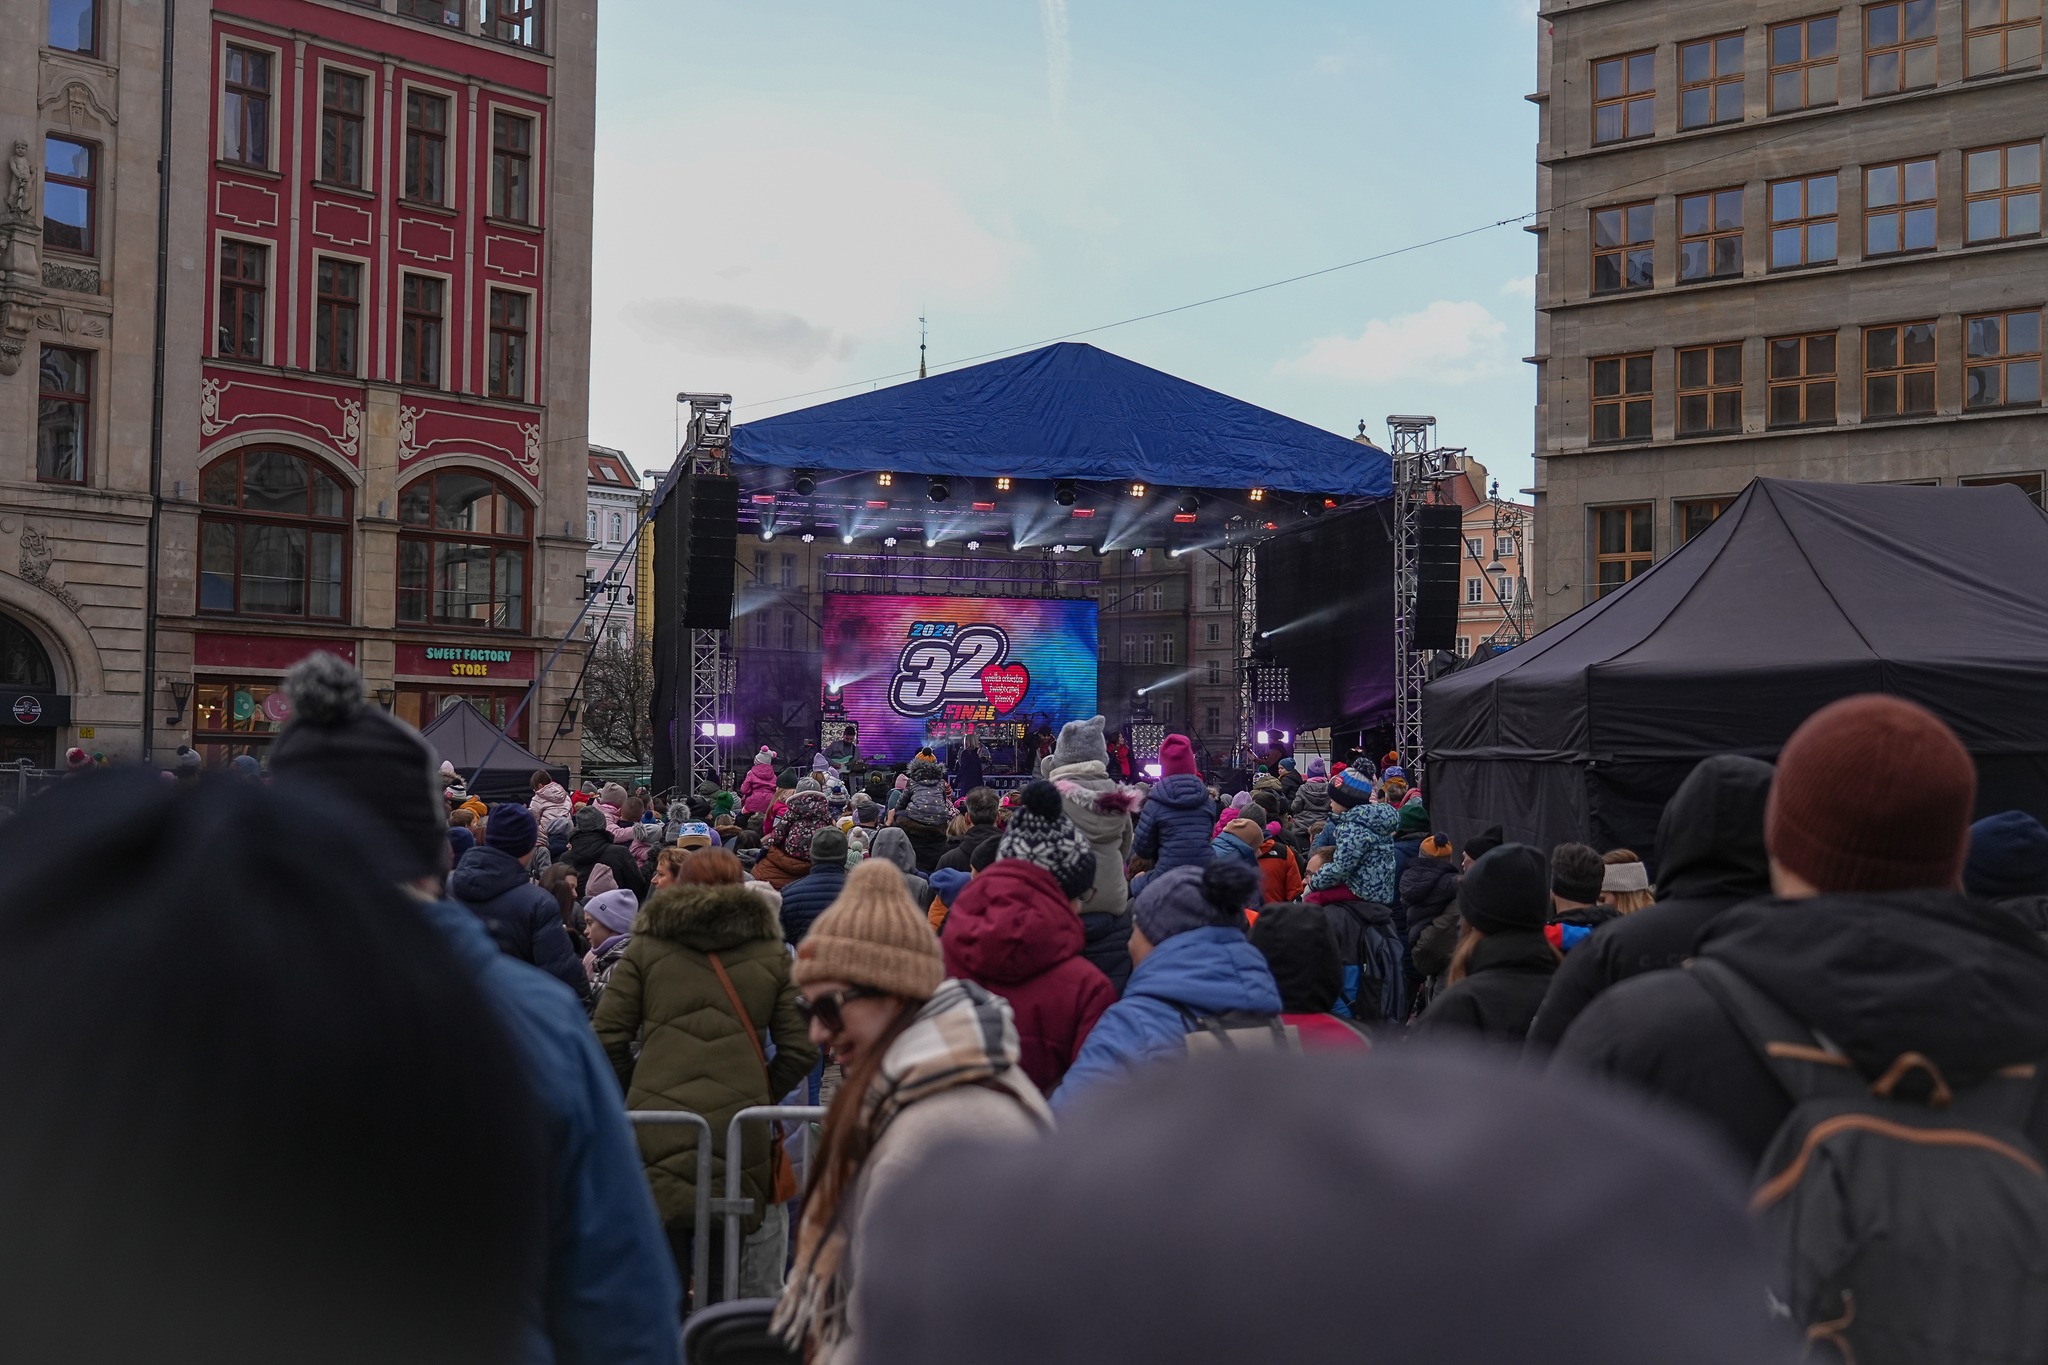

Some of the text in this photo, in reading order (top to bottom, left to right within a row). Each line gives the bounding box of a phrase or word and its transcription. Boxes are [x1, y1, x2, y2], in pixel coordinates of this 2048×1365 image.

[911, 623, 956, 637] 2024
[426, 647, 512, 662] SWEET FACTORY
[451, 663, 488, 676] STORE
[897, 633, 1001, 708] 32
